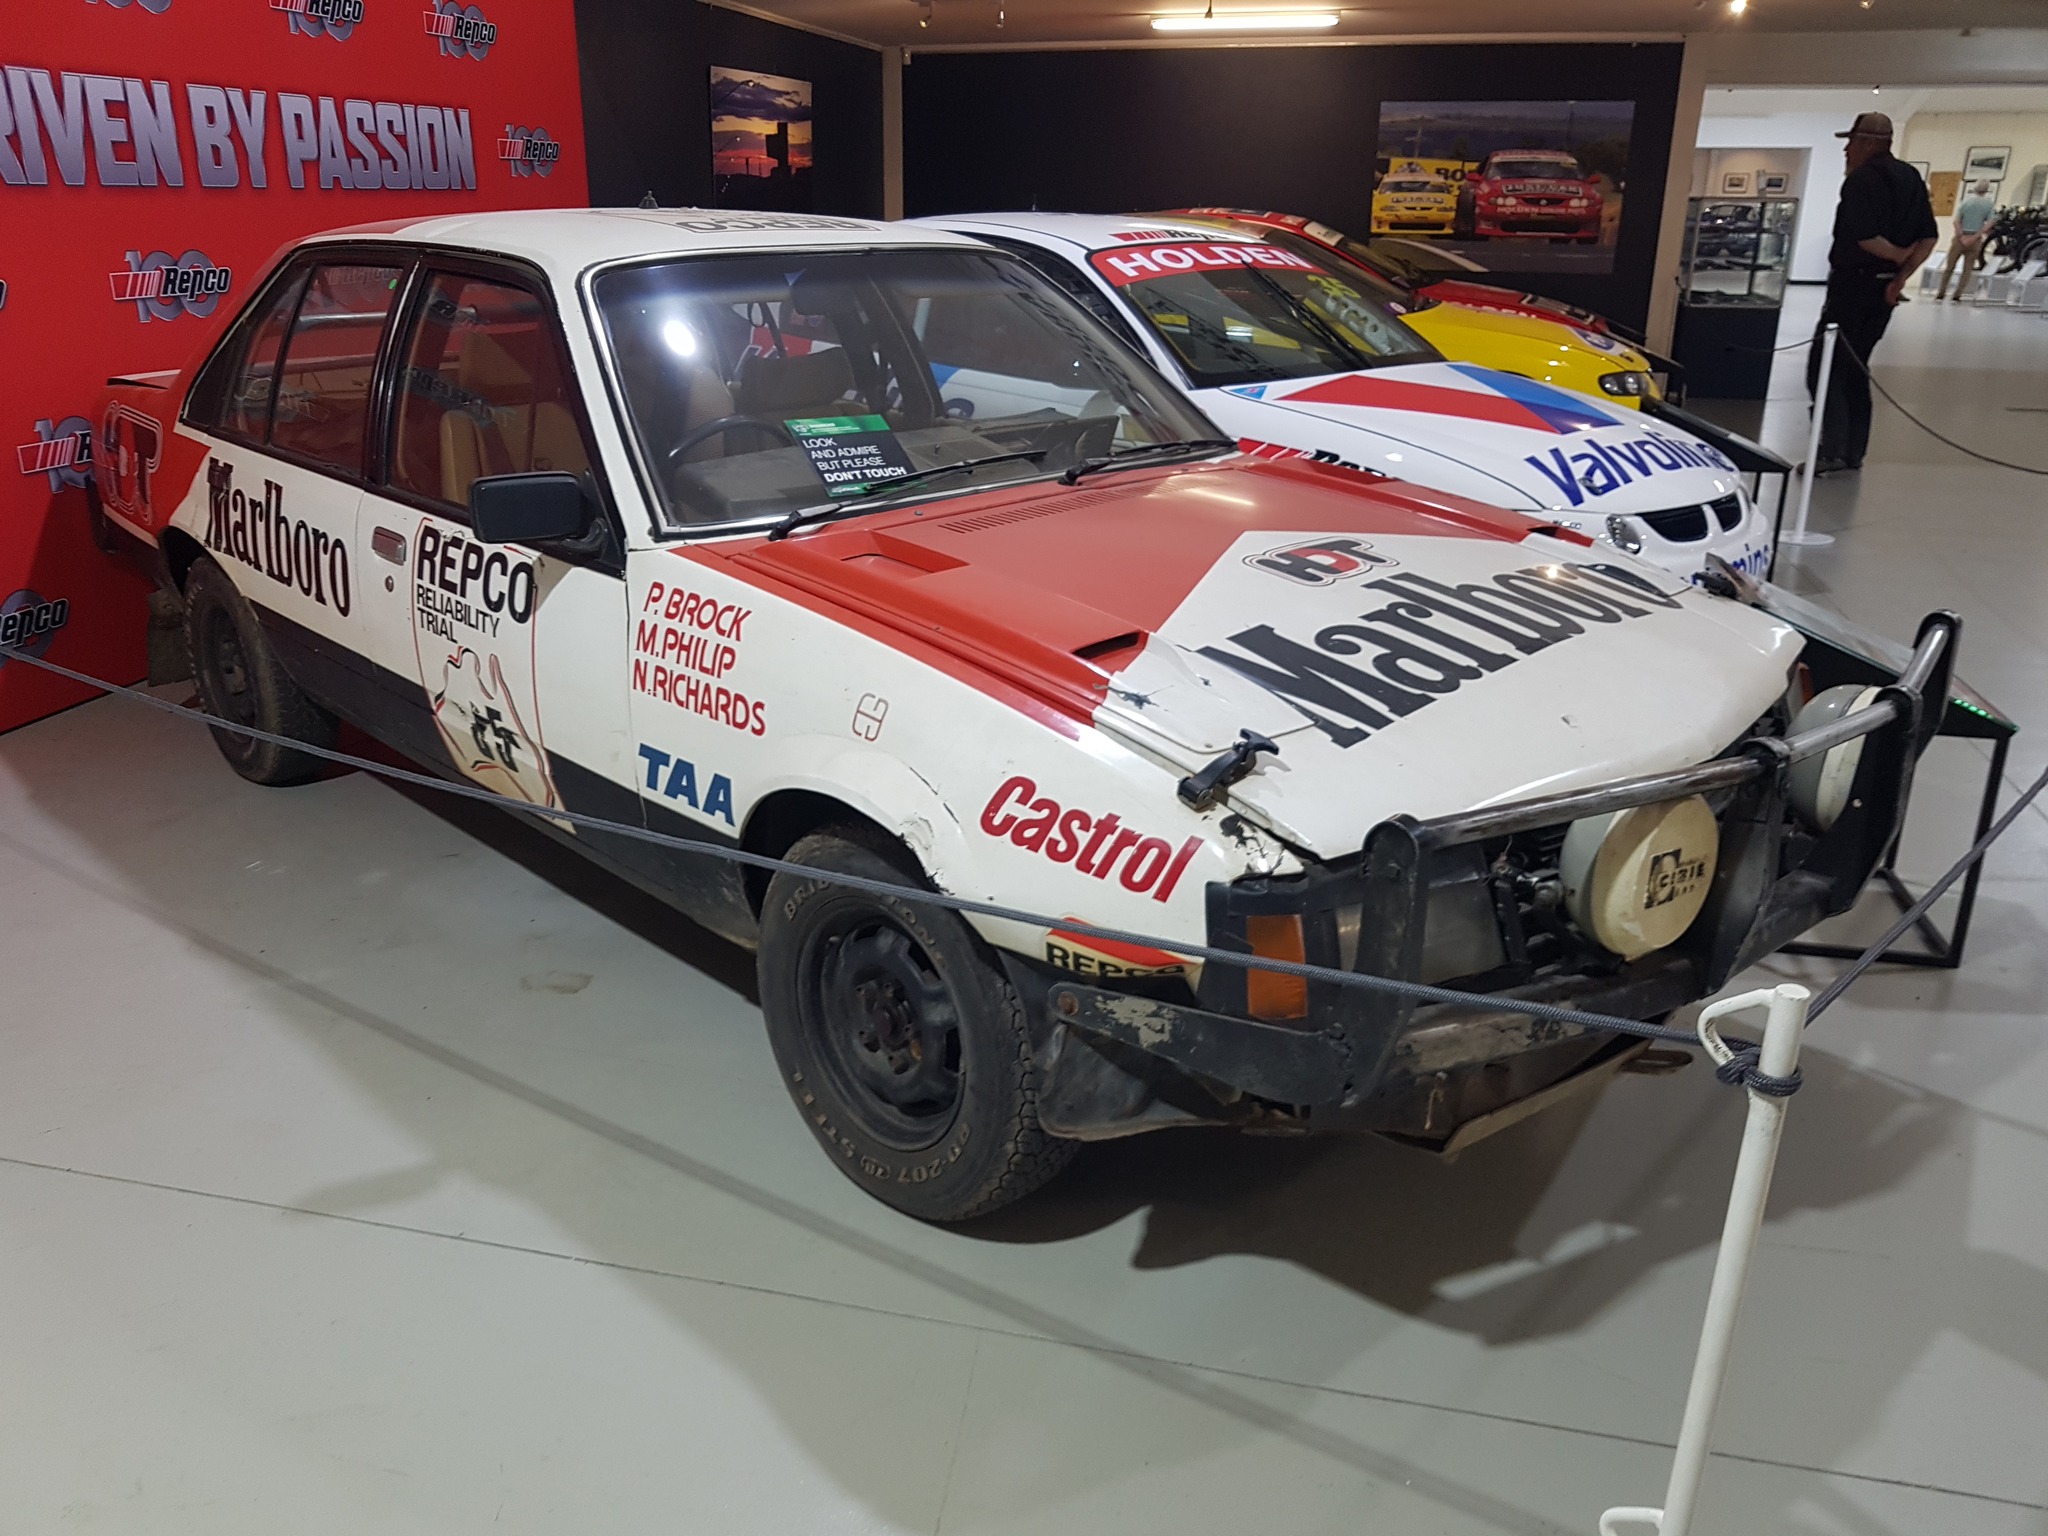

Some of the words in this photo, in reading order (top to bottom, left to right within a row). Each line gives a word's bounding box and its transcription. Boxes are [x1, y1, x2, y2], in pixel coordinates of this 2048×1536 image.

[454, 14, 497, 47] Repco
[186, 83, 267, 188] BY
[277, 92, 477, 190] PASSION
[523, 137, 560, 164] Repco
[160, 265, 232, 302] Repco
[1106, 246, 1314, 277] HOLDEN
[802, 437, 838, 449] LOOK
[811, 449, 837, 460] AND
[838, 444, 882, 459] ADMIRE
[816, 459, 841, 471] BUT
[843, 456, 887, 469] PLEASE
[823, 470, 863, 483] DON'T
[862, 466, 908, 479] TOUCH
[1524, 430, 1736, 507] Valvoline
[203, 456, 350, 618] Marlboro
[1254, 537, 1392, 585] HDT
[416, 524, 534, 625] REPCO
[0, 598, 69, 648] epco
[416, 583, 501, 638] RELIABILITY
[417, 606, 458, 644] TRIAL
[664, 587, 752, 642] BROCK
[1194, 561, 1684, 749] Marlboro
[638, 742, 736, 828] TAA
[980, 775, 1205, 903] Castrol
